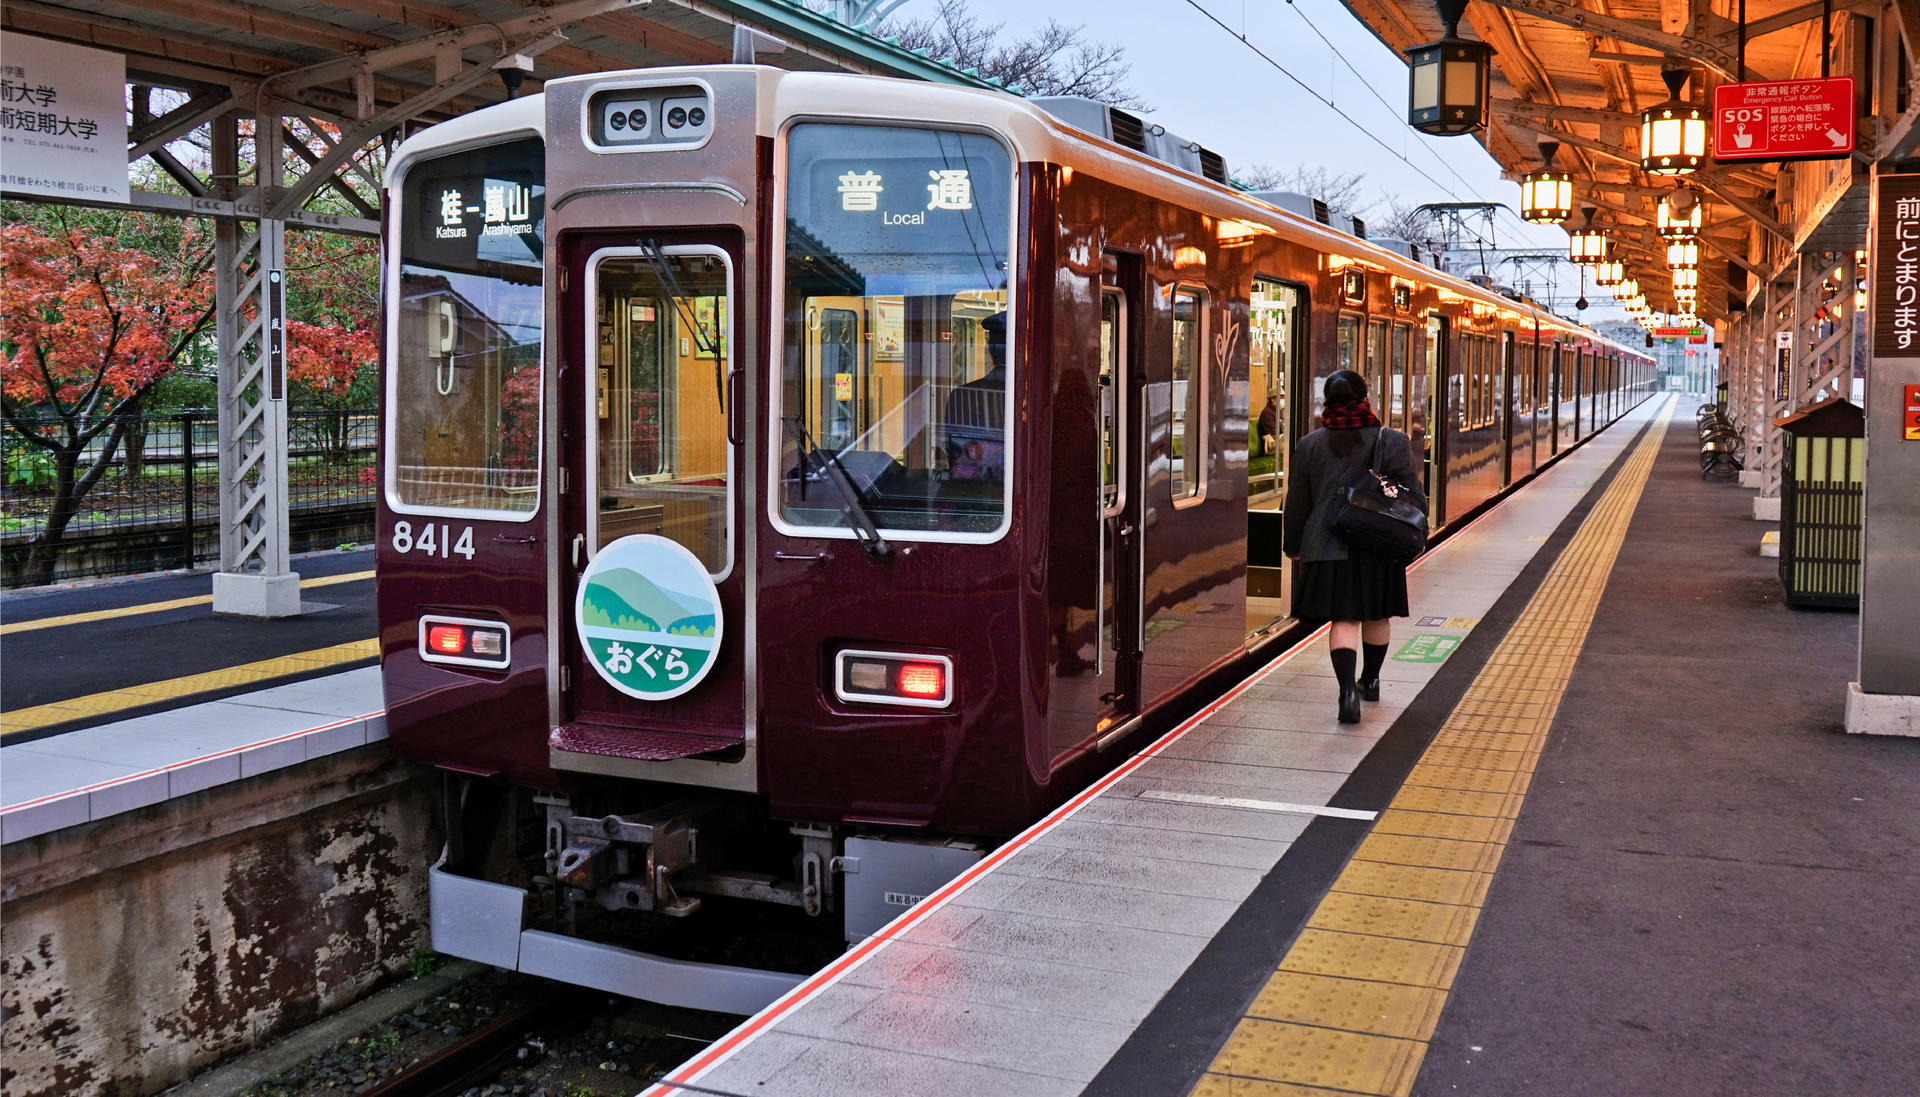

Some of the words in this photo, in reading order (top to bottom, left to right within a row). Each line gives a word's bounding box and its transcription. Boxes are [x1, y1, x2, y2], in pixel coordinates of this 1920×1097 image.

[0, 65, 25, 78] 学園
[1746, 85, 1822, 97] 非常通報ボタン
[1743, 96, 1782, 105] Emergency
[1725, 109, 1763, 123] SOS
[1770, 114, 1822, 124] 緊急の場合に
[1770, 122, 1831, 133] ボタンを押して
[1770, 134, 1805, 142] ください
[837, 170, 972, 211] 普通
[883, 211, 925, 225] Local
[436, 226, 467, 239] Katsura
[482, 223, 532, 237] Arashiyama
[1894, 197, 1920, 349] 前にとまります
[392, 520, 476, 560] 8414
[604, 641, 690, 681] おぐら
[888, 894, 925, 905] 連結器中
